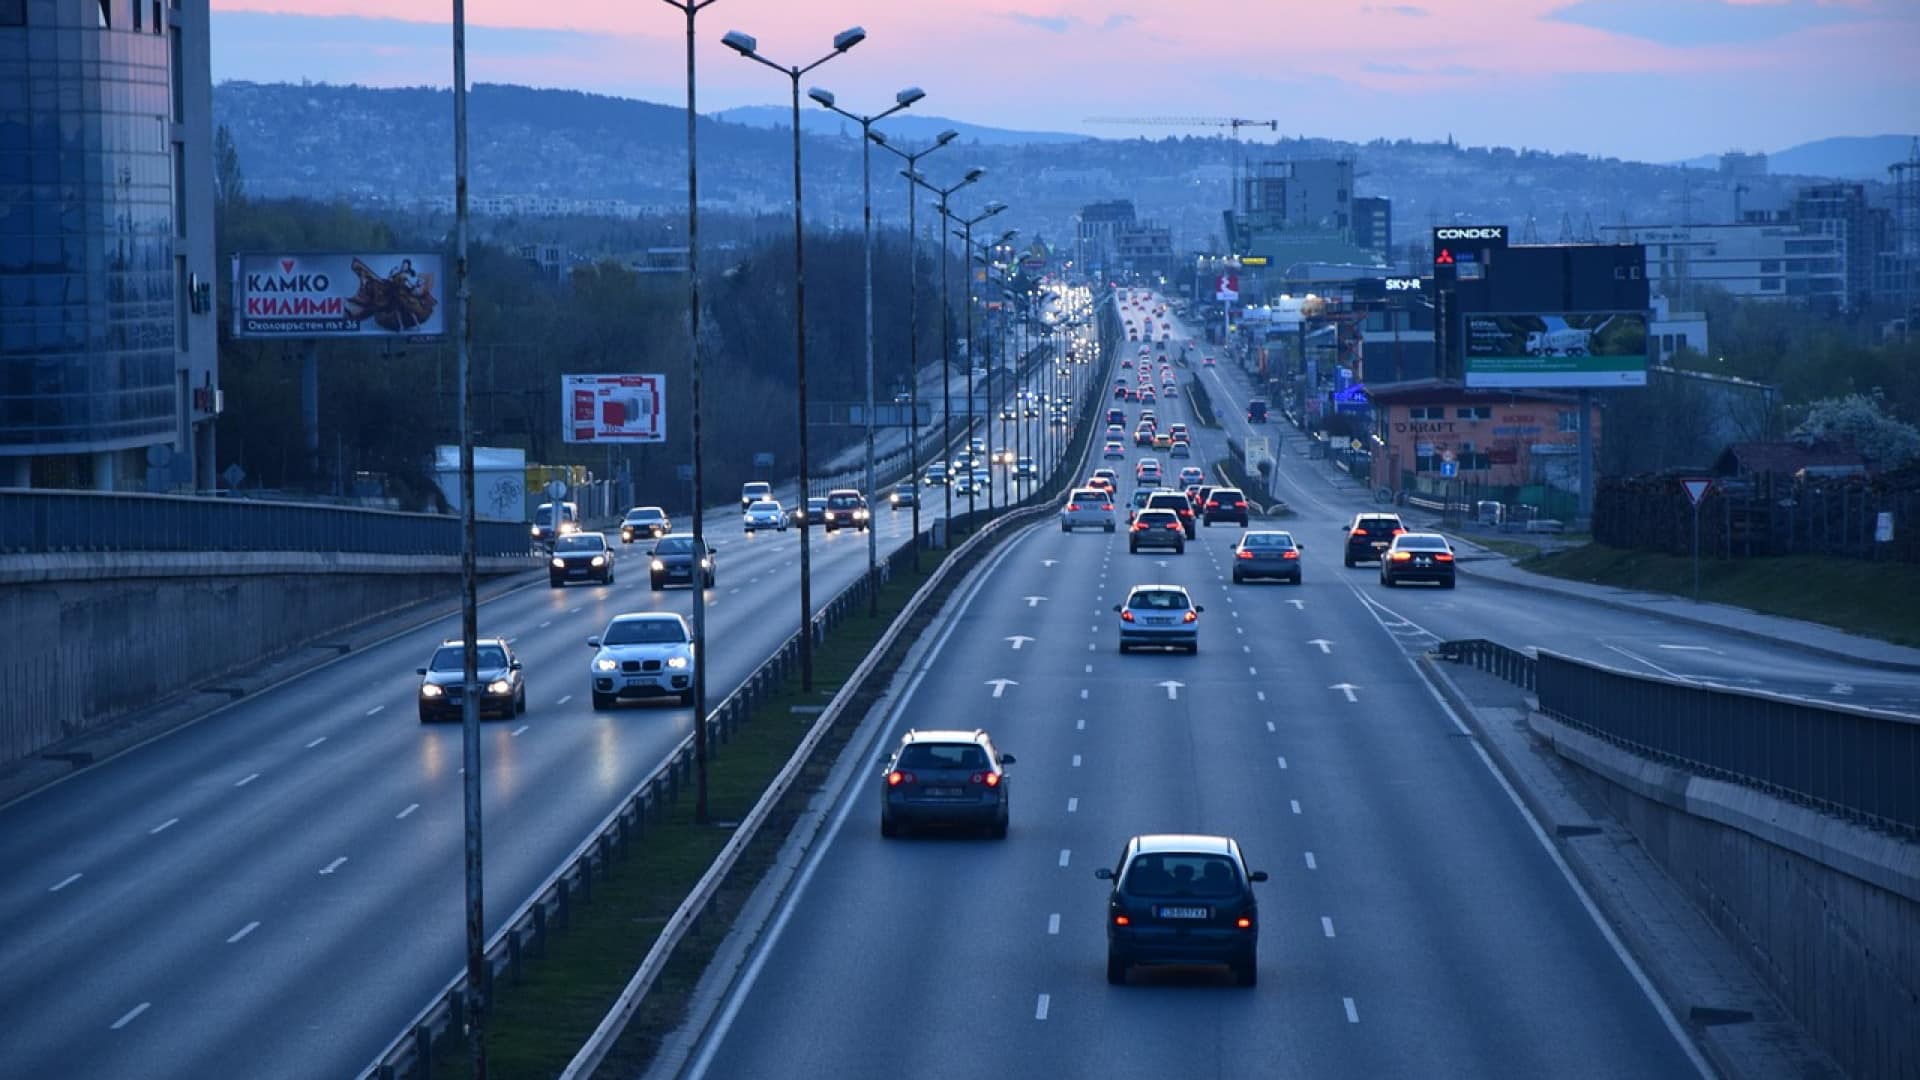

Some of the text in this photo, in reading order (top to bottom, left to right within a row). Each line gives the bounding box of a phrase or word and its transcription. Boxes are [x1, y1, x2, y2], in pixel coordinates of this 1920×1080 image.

[1437, 228, 1502, 239] CONDEX
[248, 274, 329, 292] КАМКО
[248, 297, 342, 315] КИЛИМИ
[248, 320, 323, 331] Околовръстен
[326, 321, 343, 331] път
[1409, 422, 1456, 433] KRAFT
